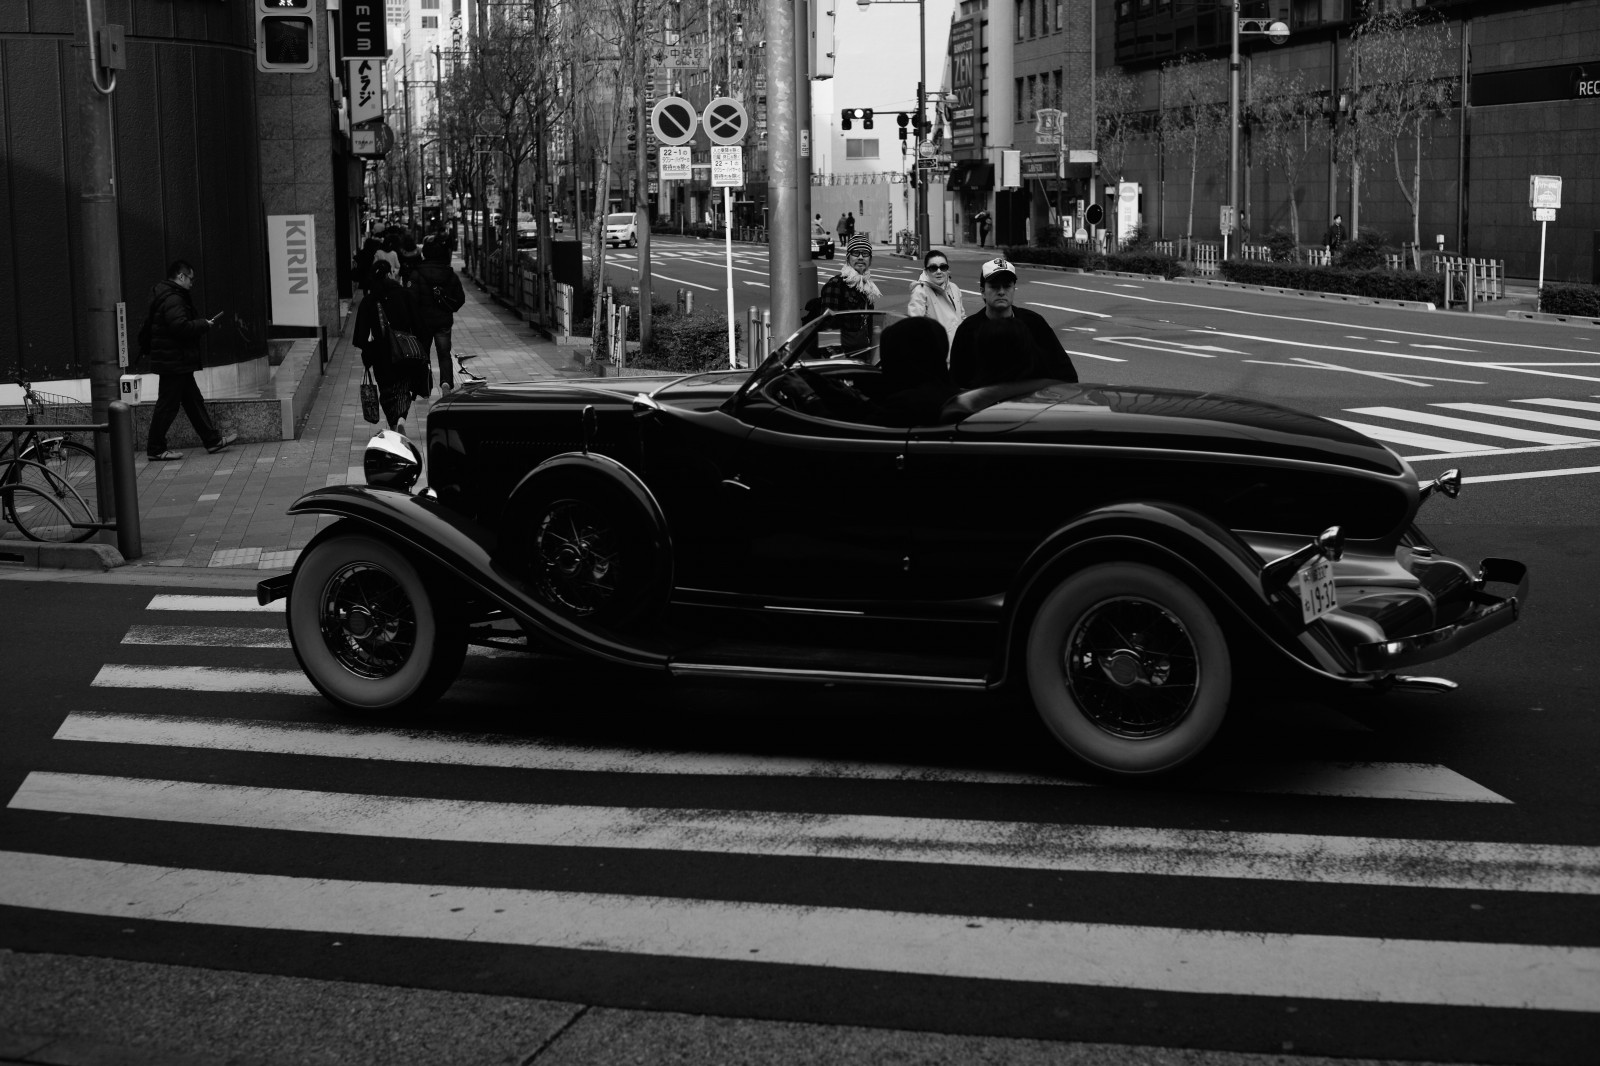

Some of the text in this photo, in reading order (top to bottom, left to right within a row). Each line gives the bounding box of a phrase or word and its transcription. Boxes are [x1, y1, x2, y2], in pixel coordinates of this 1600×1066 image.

[953, 53, 973, 87] ZEN
[285, 220, 309, 294] KIRIN
[1310, 580, 1336, 616] 19-32
